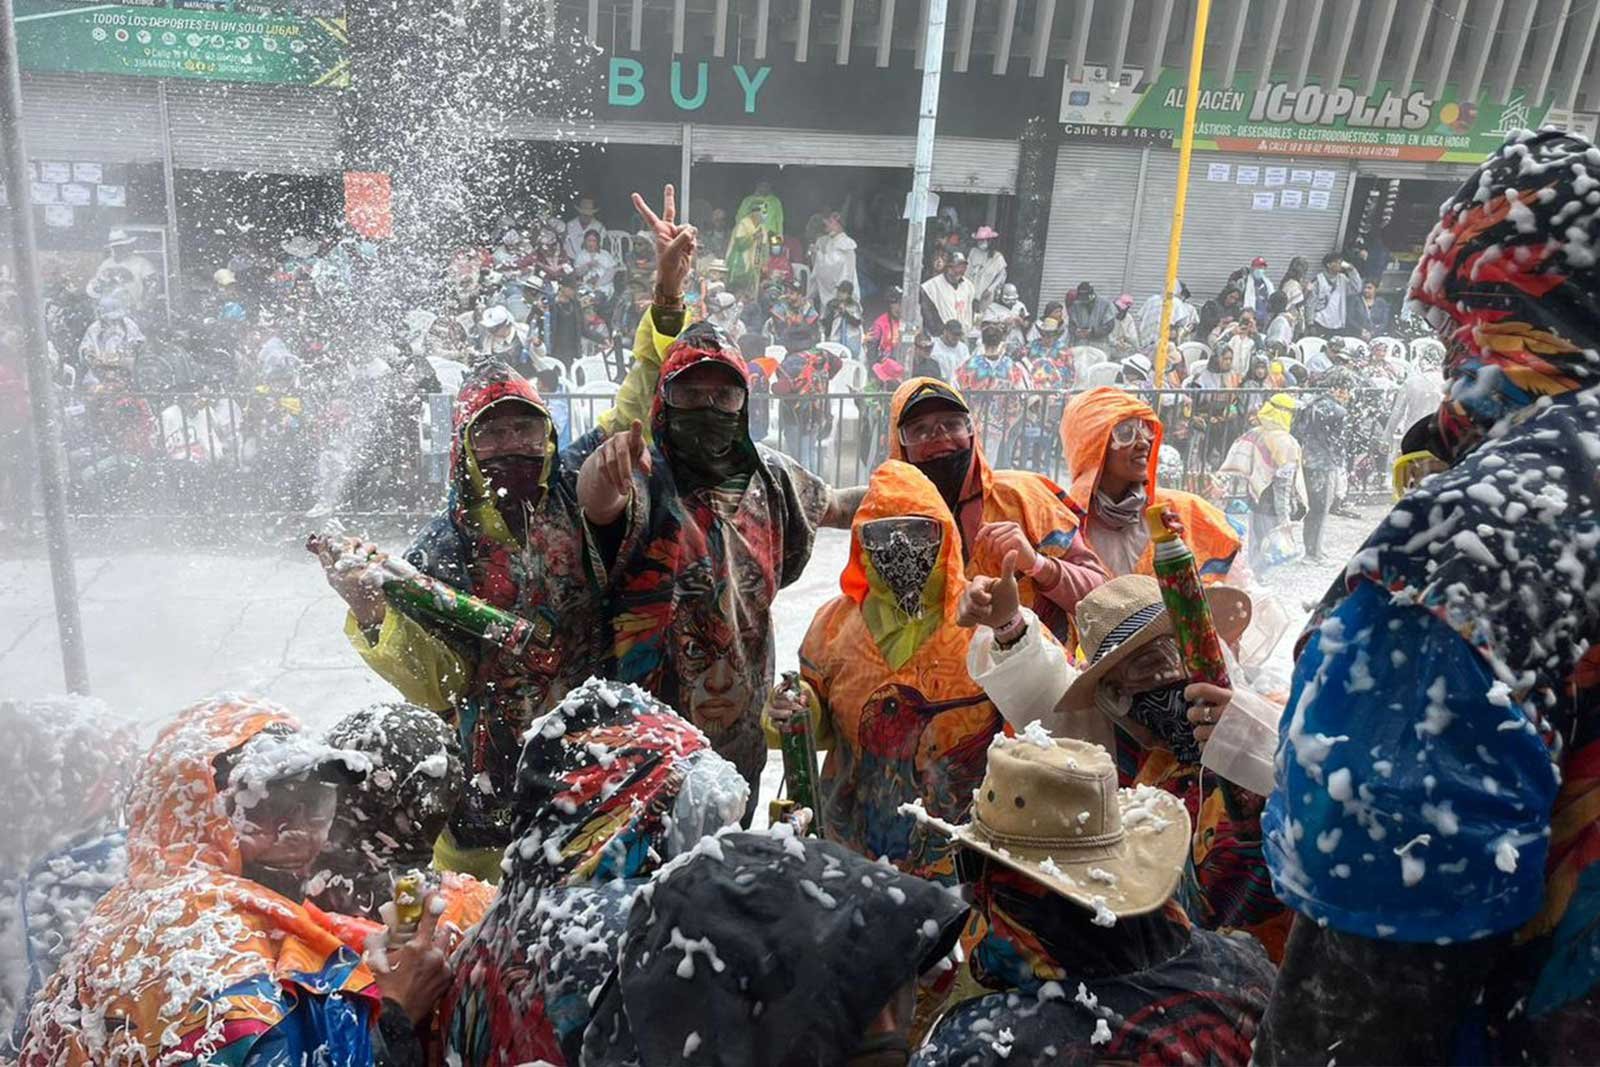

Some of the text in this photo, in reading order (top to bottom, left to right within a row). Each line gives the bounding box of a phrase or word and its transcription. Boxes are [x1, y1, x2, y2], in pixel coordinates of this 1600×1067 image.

[92, 14, 126, 25] TODOS
[127, 16, 148, 26] LOS
[149, 17, 203, 30] DEPORTES
[204, 20, 219, 31] EN
[221, 21, 236, 32] UN
[238, 22, 264, 34] SOLO
[608, 57, 771, 113] BUY
[1163, 82, 1434, 131] ALACÉN ICOPLAS
[1064, 124, 1098, 136] Calle
[1102, 127, 1117, 137] 18
[1134, 128, 1147, 138] 18
[1159, 129, 1175, 140] 02
[1194, 122, 1232, 136] LÁSTICOS
[1237, 125, 1292, 139] DESECHABLES
[1408, 134, 1419, 145] EN
[1444, 136, 1471, 148] HOGAR
